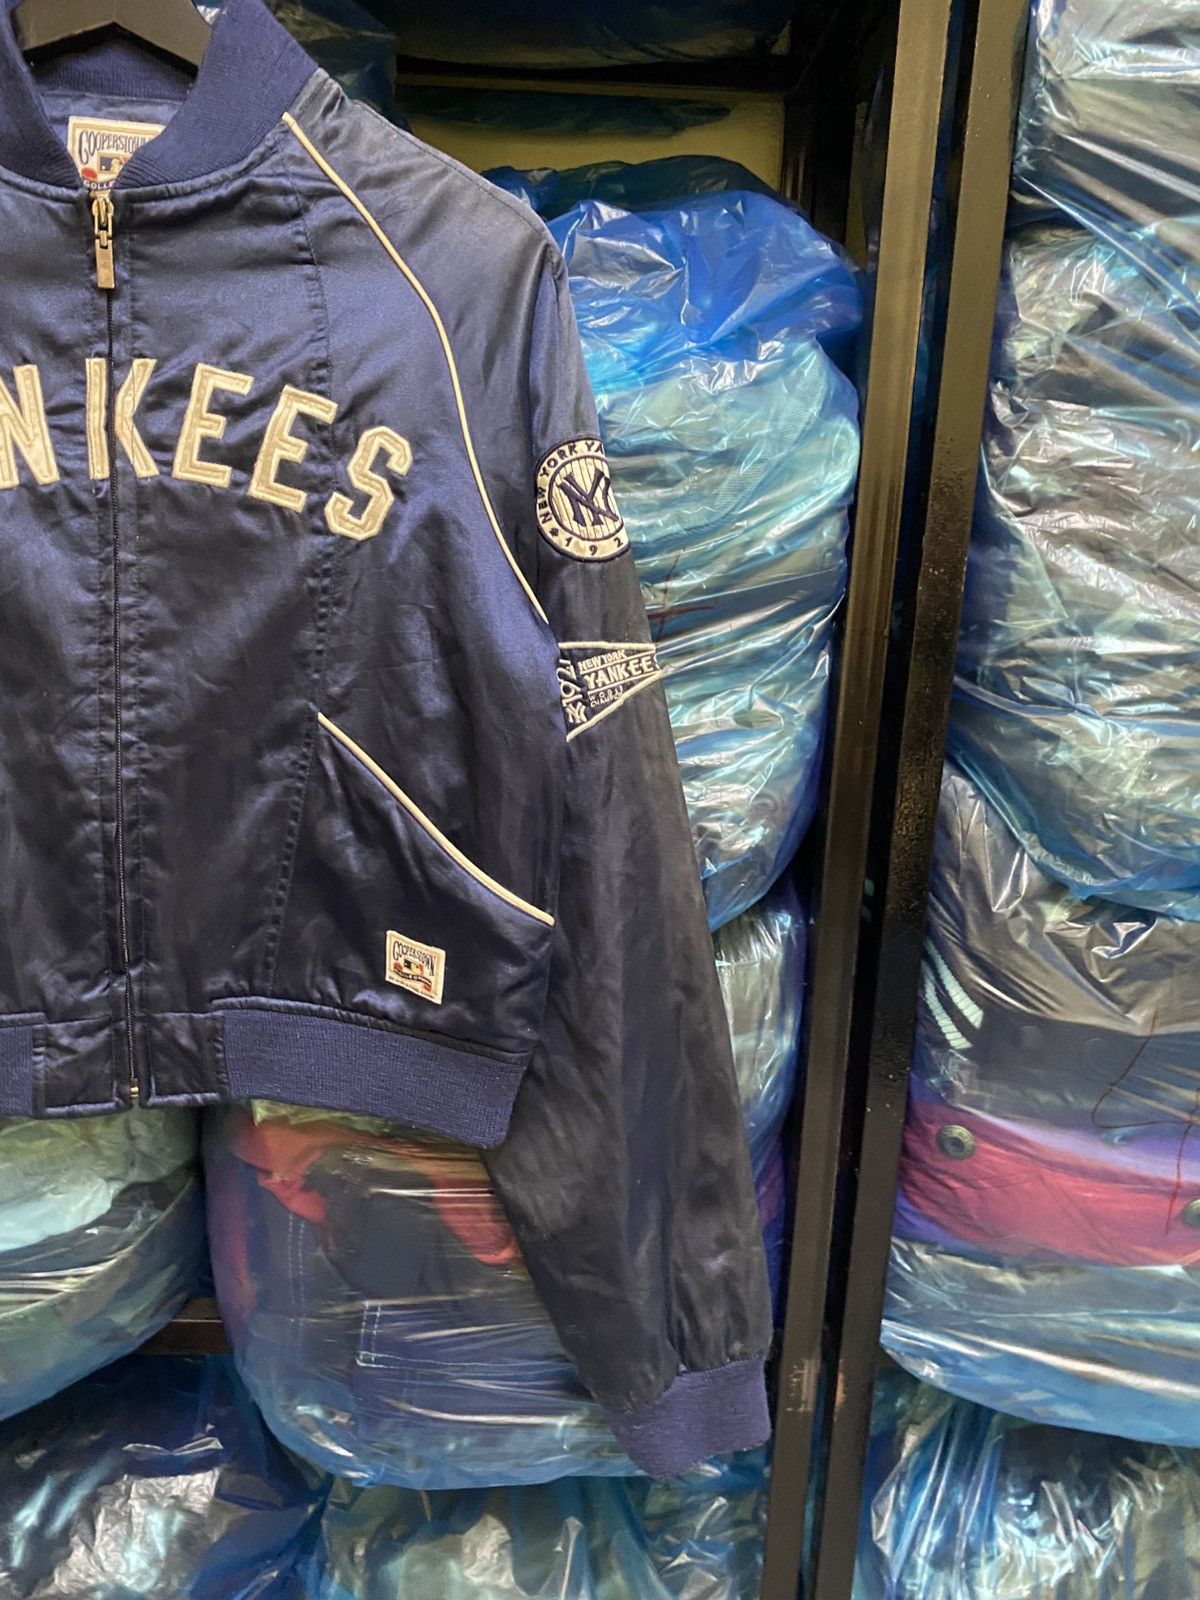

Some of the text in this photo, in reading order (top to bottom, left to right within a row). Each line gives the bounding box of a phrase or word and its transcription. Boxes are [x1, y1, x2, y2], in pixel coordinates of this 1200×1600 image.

[0, 357, 412, 541] NKEES
[540, 443, 578, 477] YORK
[538, 487, 552, 524] NEW
[578, 649, 628, 671] NEW YORK
